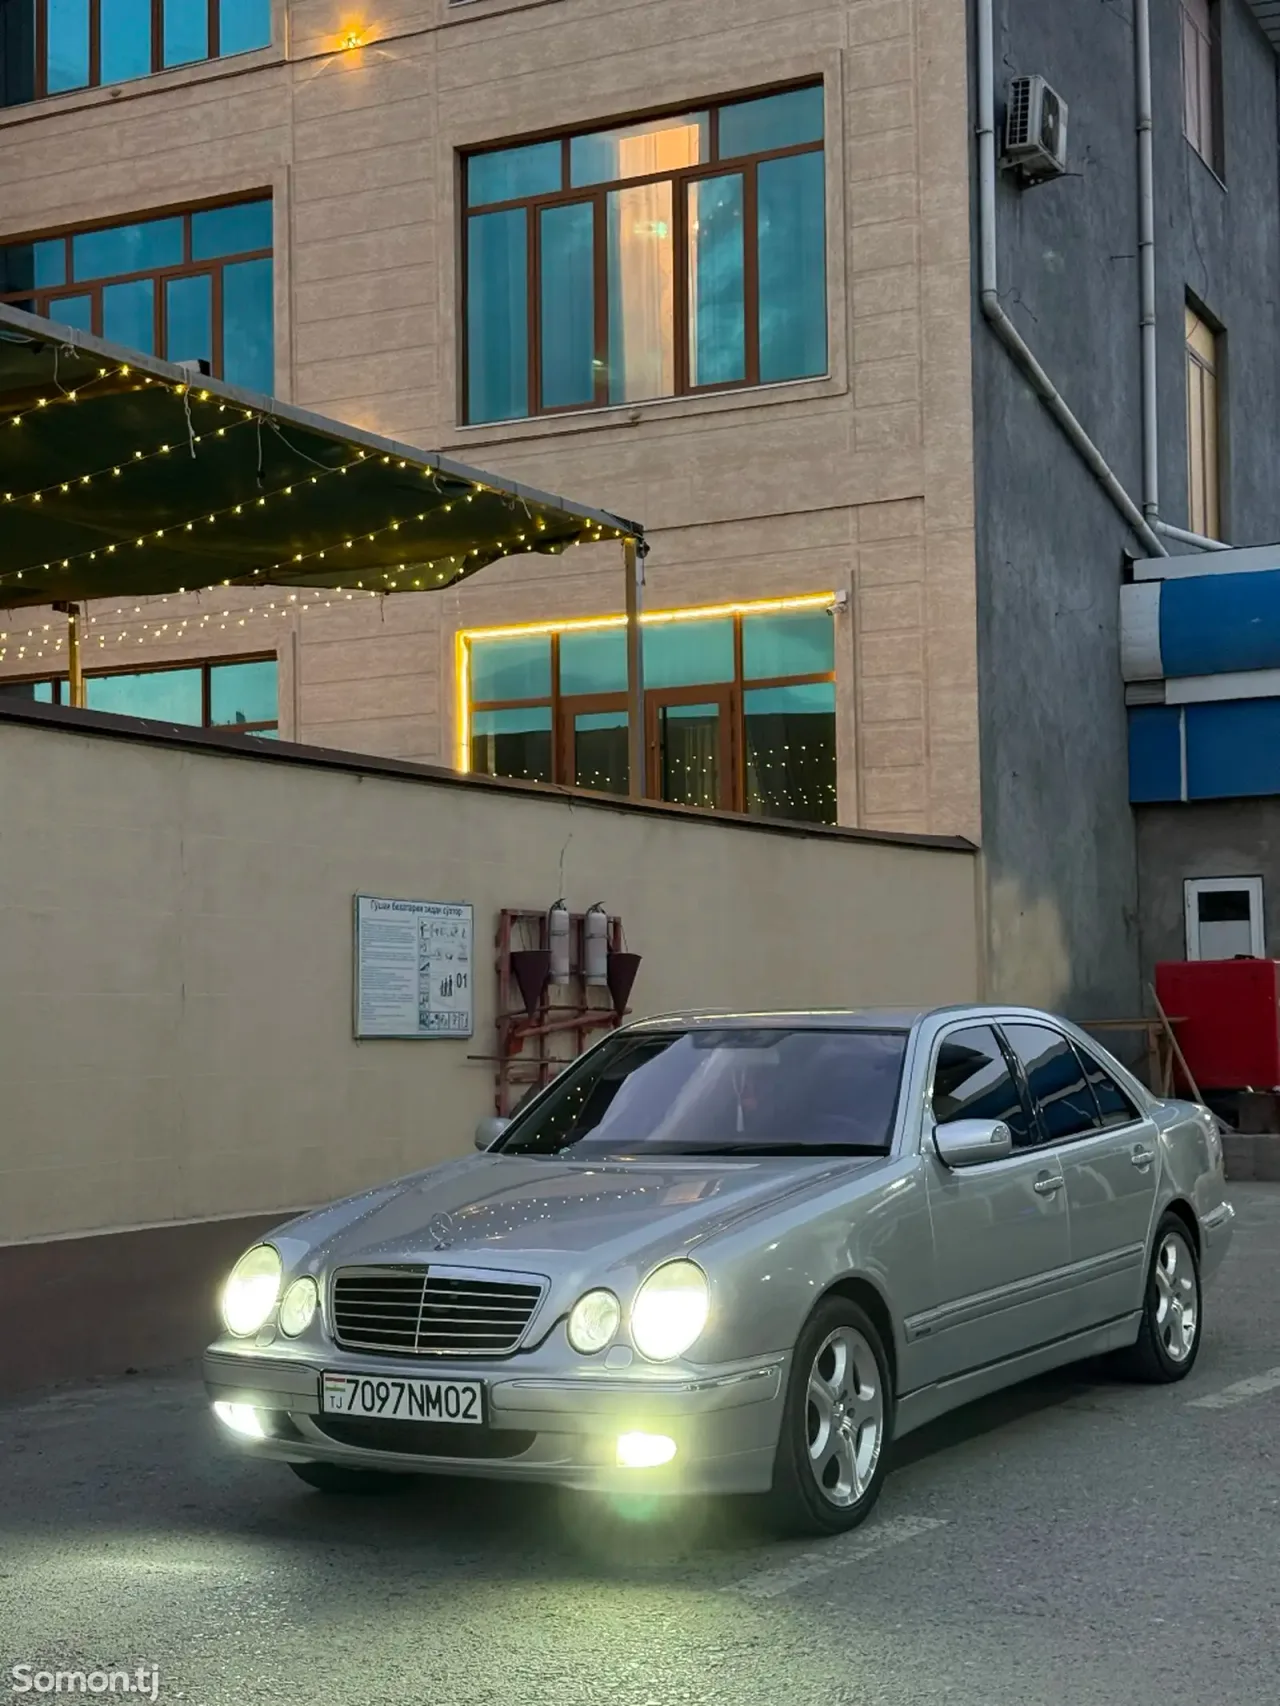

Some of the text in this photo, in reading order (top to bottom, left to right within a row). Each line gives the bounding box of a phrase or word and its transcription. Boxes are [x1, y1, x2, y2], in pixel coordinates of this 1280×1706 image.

[456, 973, 467, 988] 01
[329, 1396, 343, 1409] TJ
[346, 1379, 478, 1419] 7097NM02
